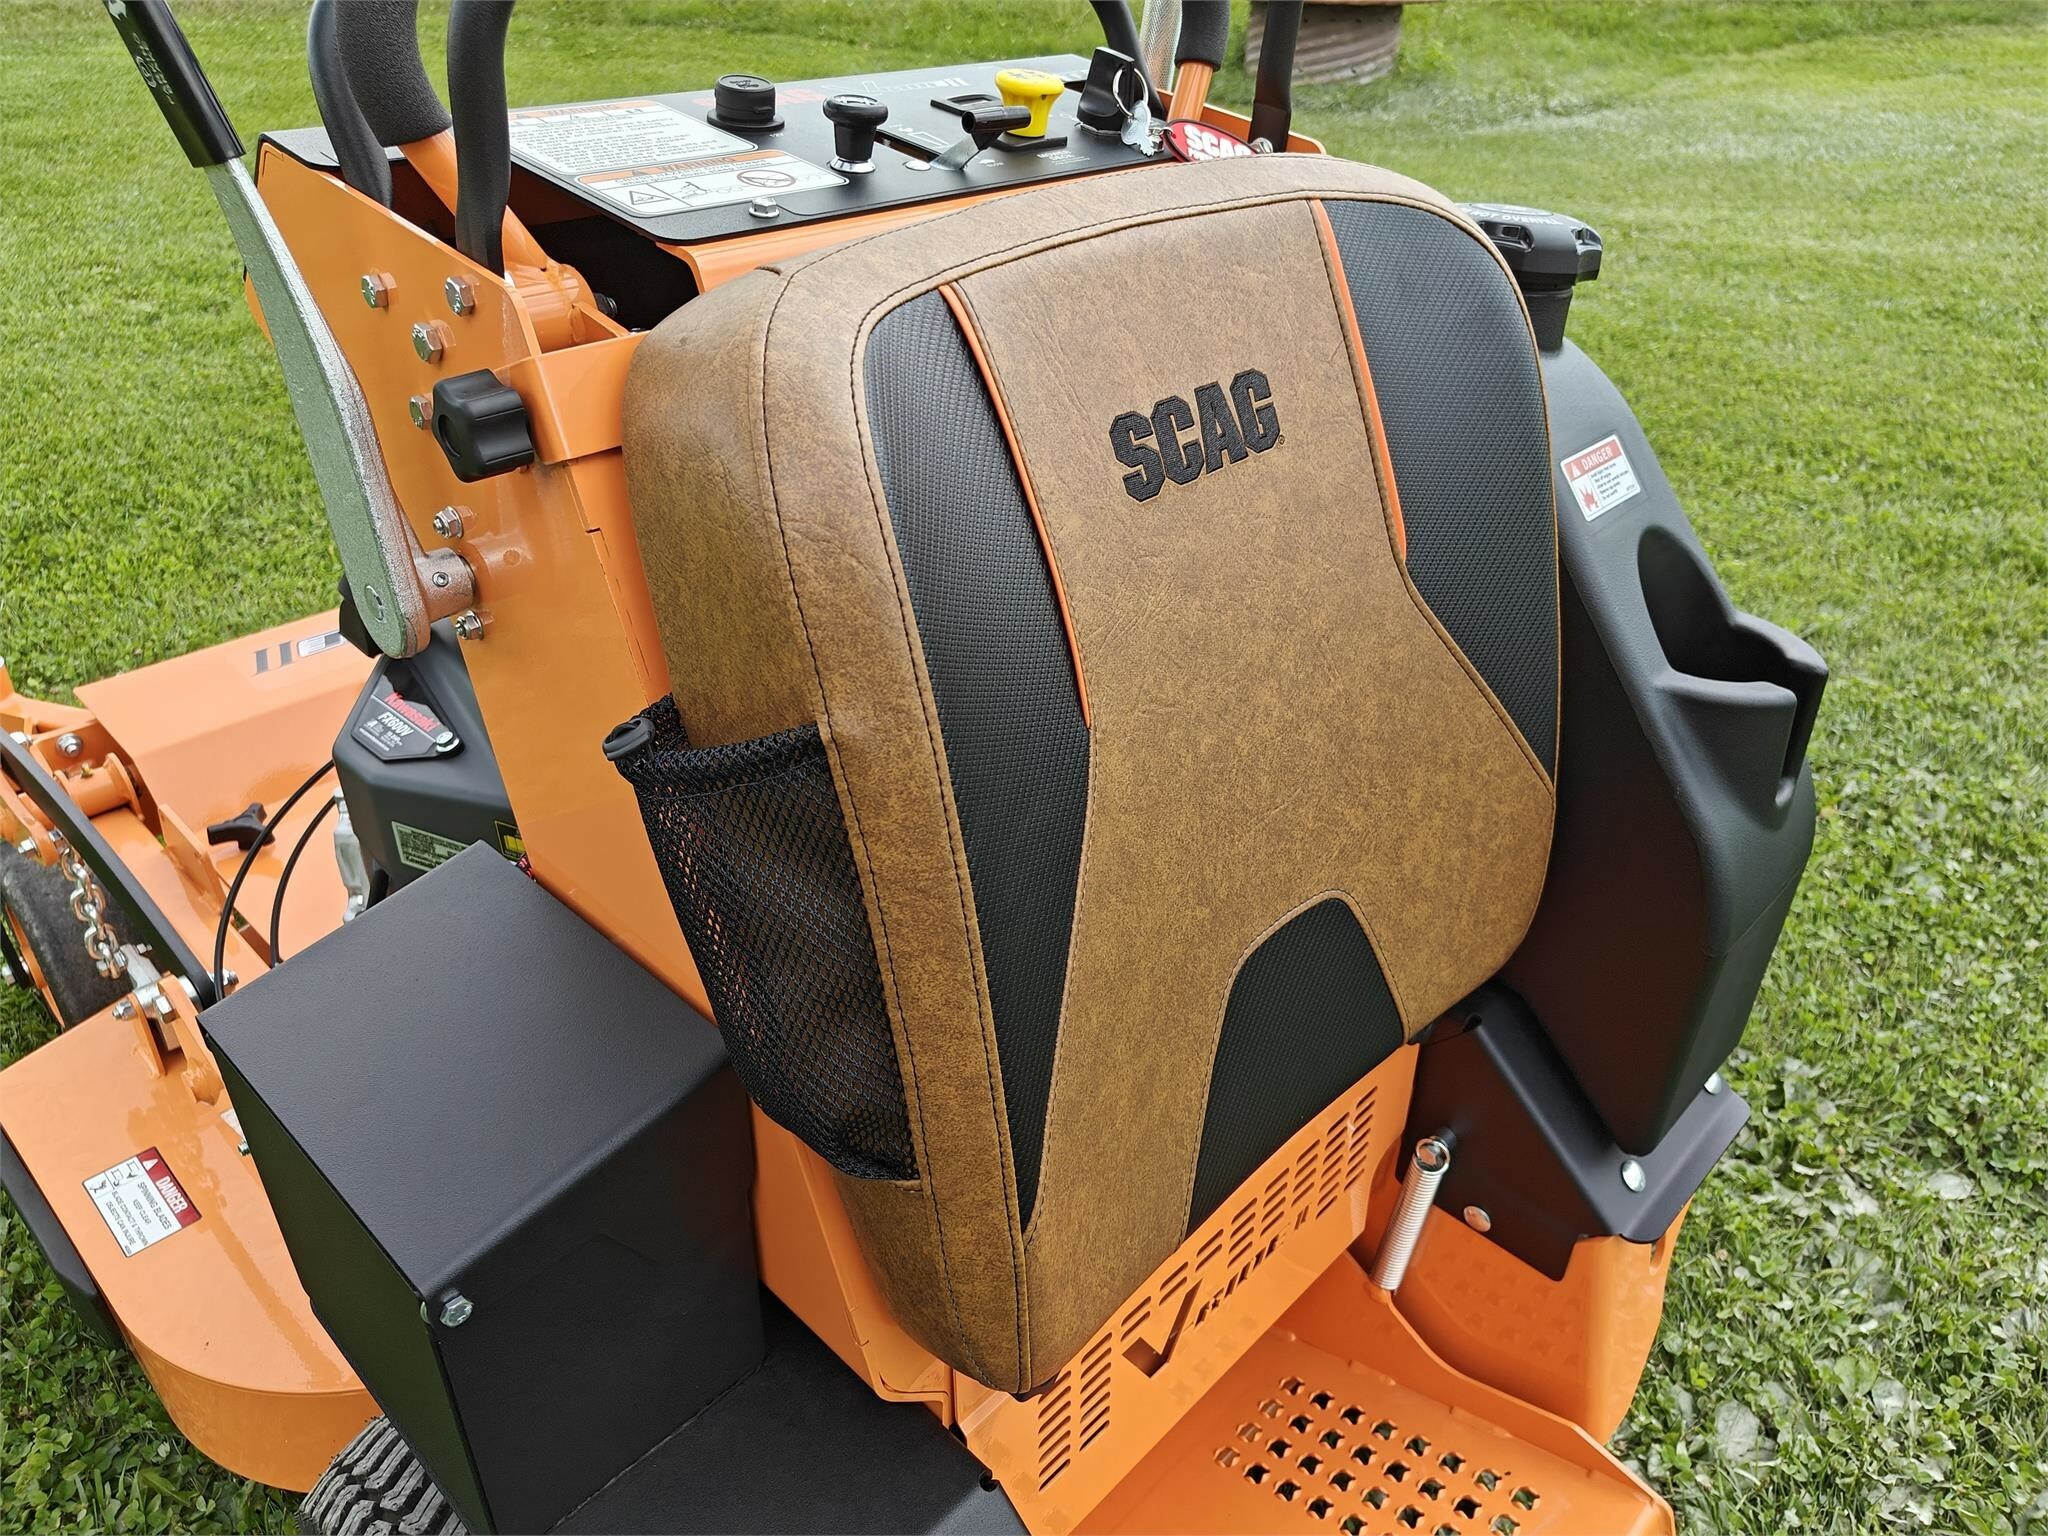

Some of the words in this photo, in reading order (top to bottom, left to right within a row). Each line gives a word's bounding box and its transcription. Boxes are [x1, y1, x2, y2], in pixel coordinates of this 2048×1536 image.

[1109, 368, 1280, 502] SCAG
[1581, 446, 1614, 471] DANGER
[377, 711, 415, 737] FX600V
[384, 691, 440, 733] Kawasaki
[137, 1182, 158, 1208] SPINNING
[152, 1206, 172, 1230] BLADES
[155, 1175, 189, 1214] DANGER
[131, 1198, 143, 1211] KEEP
[138, 1209, 152, 1225] CLEAR
[132, 1225, 149, 1246] THROWN
